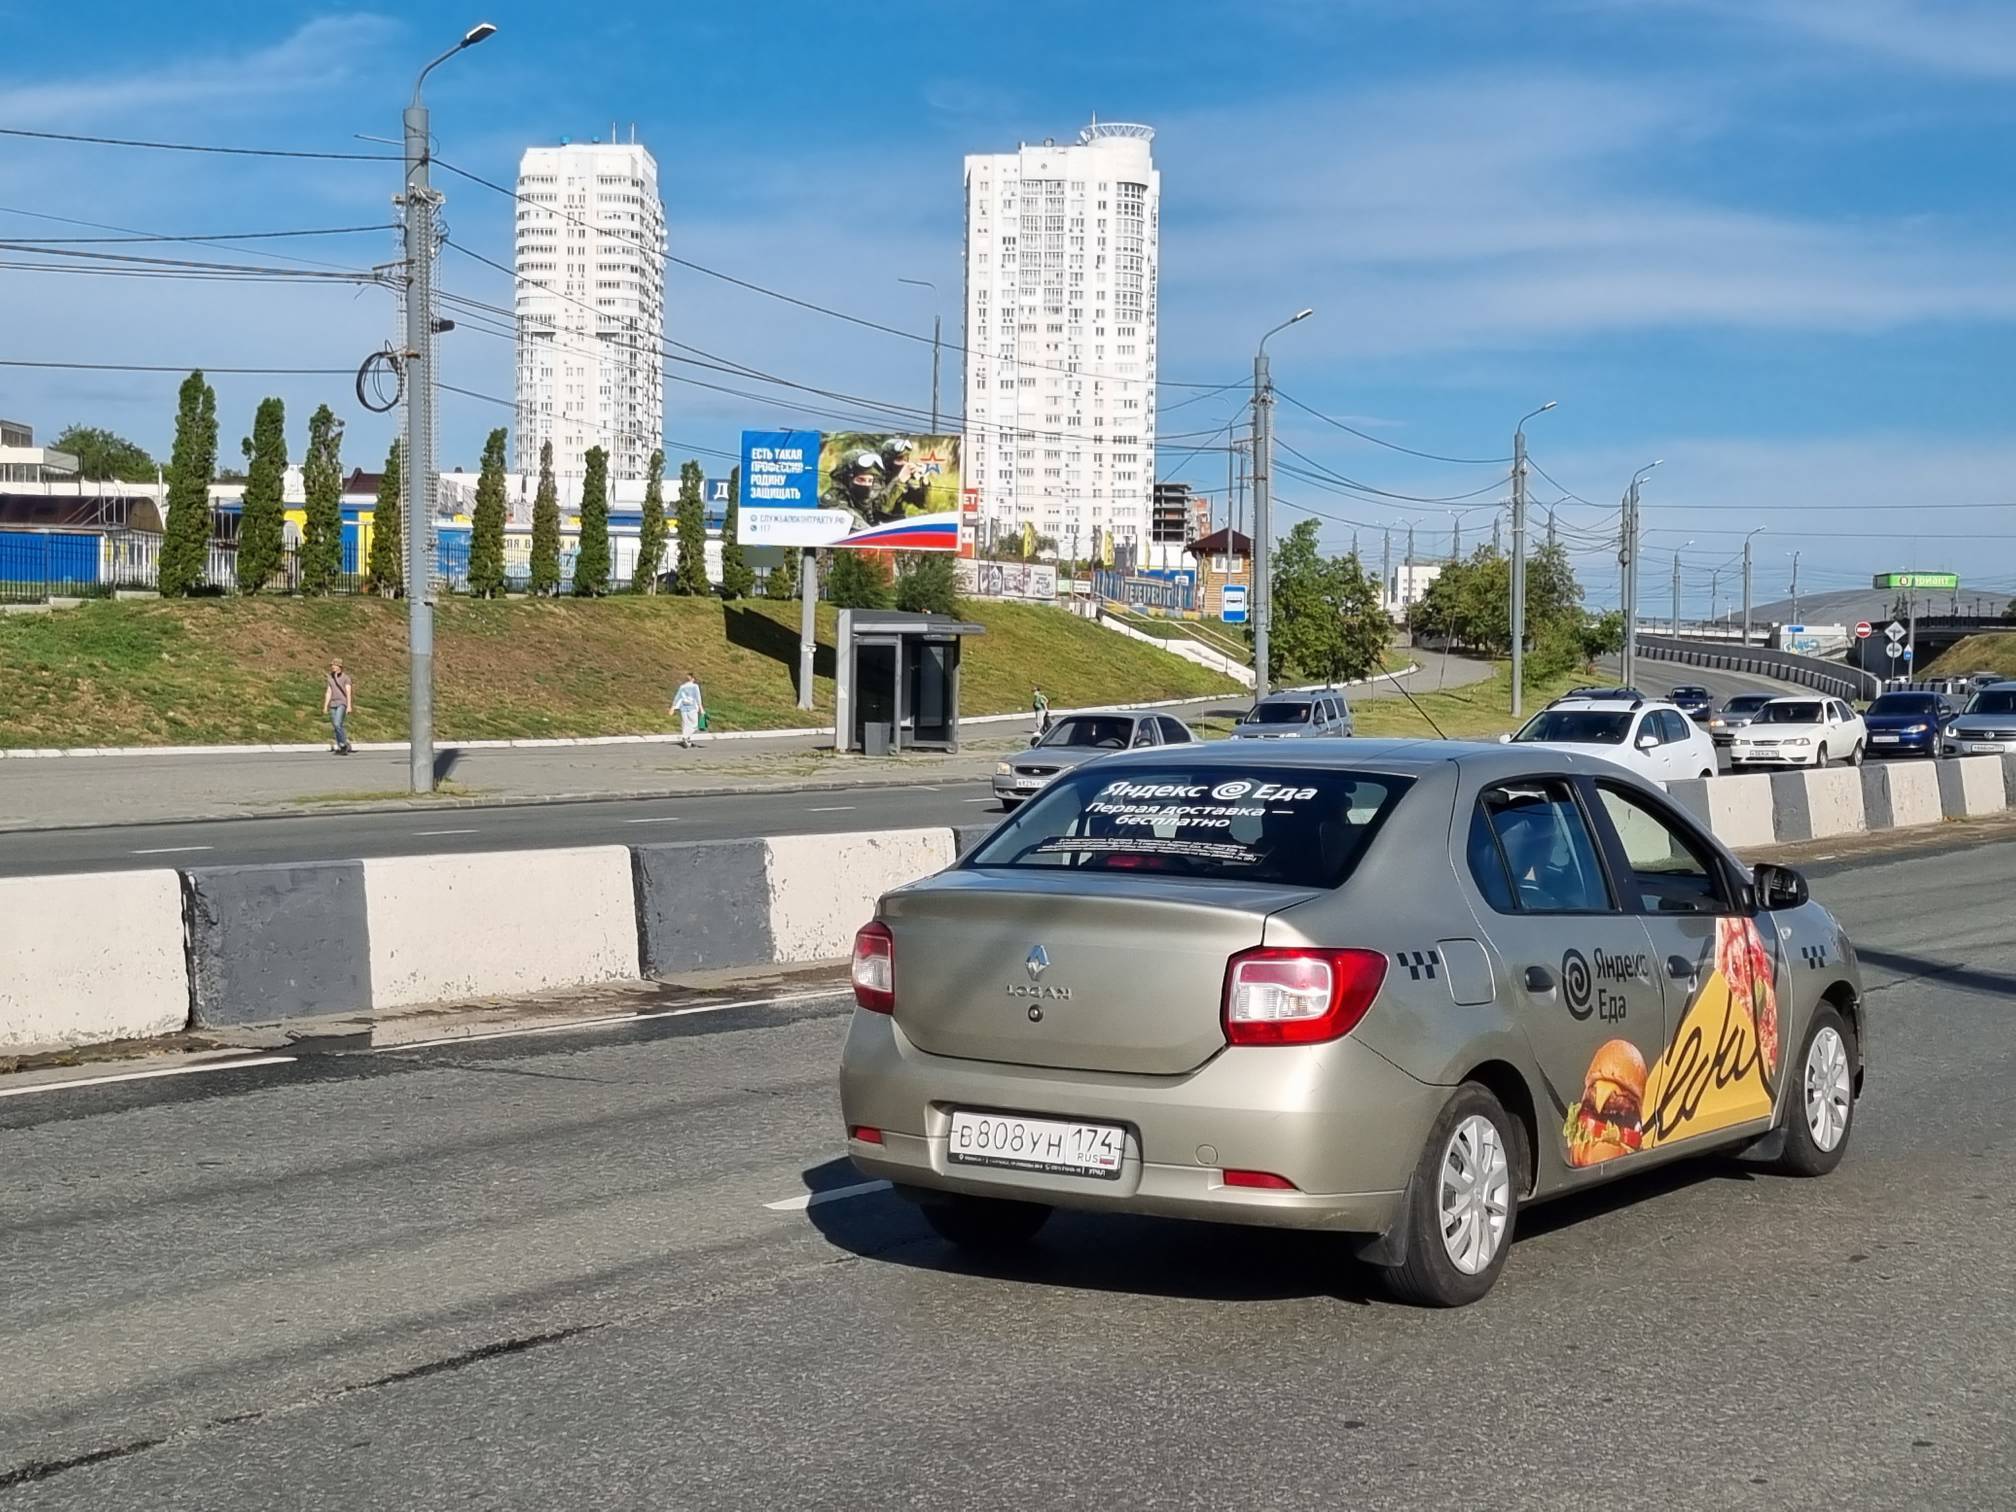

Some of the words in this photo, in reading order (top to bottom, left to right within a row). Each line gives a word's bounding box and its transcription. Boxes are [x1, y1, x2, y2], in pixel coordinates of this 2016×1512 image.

[751, 447, 773, 460] ЕСТЬ
[774, 448, 803, 461] ТАКАЯ
[751, 460, 804, 473] ПРОФЕССИЯ
[750, 474, 787, 487] РОДИНУ
[750, 487, 801, 500] ЗАЩИЩАТЬ
[1101, 781, 1209, 799] Яндекс
[1252, 783, 1319, 801] Еда
[1085, 802, 1162, 815] Первая
[1159, 805, 1267, 817] доставка
[1114, 815, 1231, 828] бесплатно
[1593, 947, 1649, 982] Яндекс
[1006, 984, 1072, 1001] LOGAN
[1599, 987, 1627, 1024] Еда
[959, 1119, 1063, 1159] В808УН
[1071, 1126, 1113, 1155] 174
[1077, 1153, 1098, 1164] RUS
